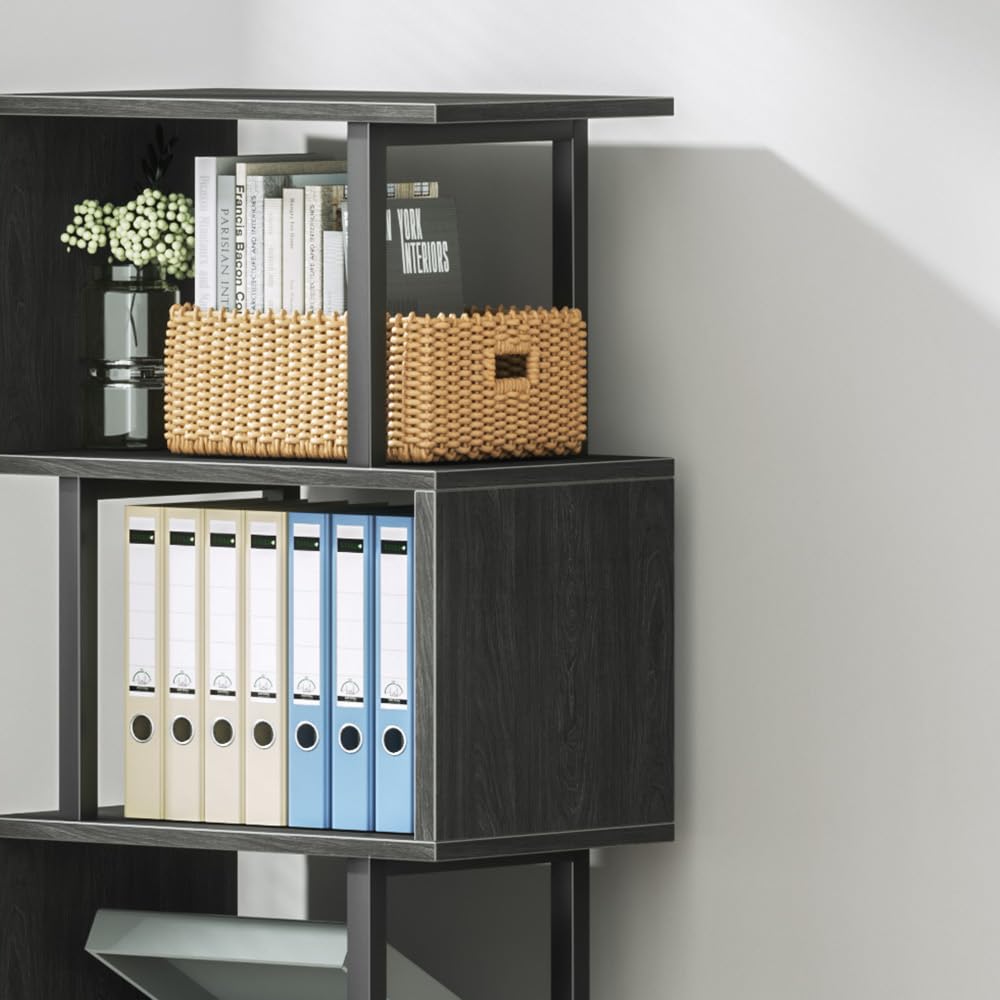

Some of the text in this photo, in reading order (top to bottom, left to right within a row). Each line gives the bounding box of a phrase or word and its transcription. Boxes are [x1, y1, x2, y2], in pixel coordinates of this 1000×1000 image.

[235, 184, 245, 236] Francis
[397, 208, 423, 240] YORK
[220, 208, 230, 276] PARISIAN
[235, 242, 245, 286] Bacon
[402, 241, 450, 274] INTERIORS
